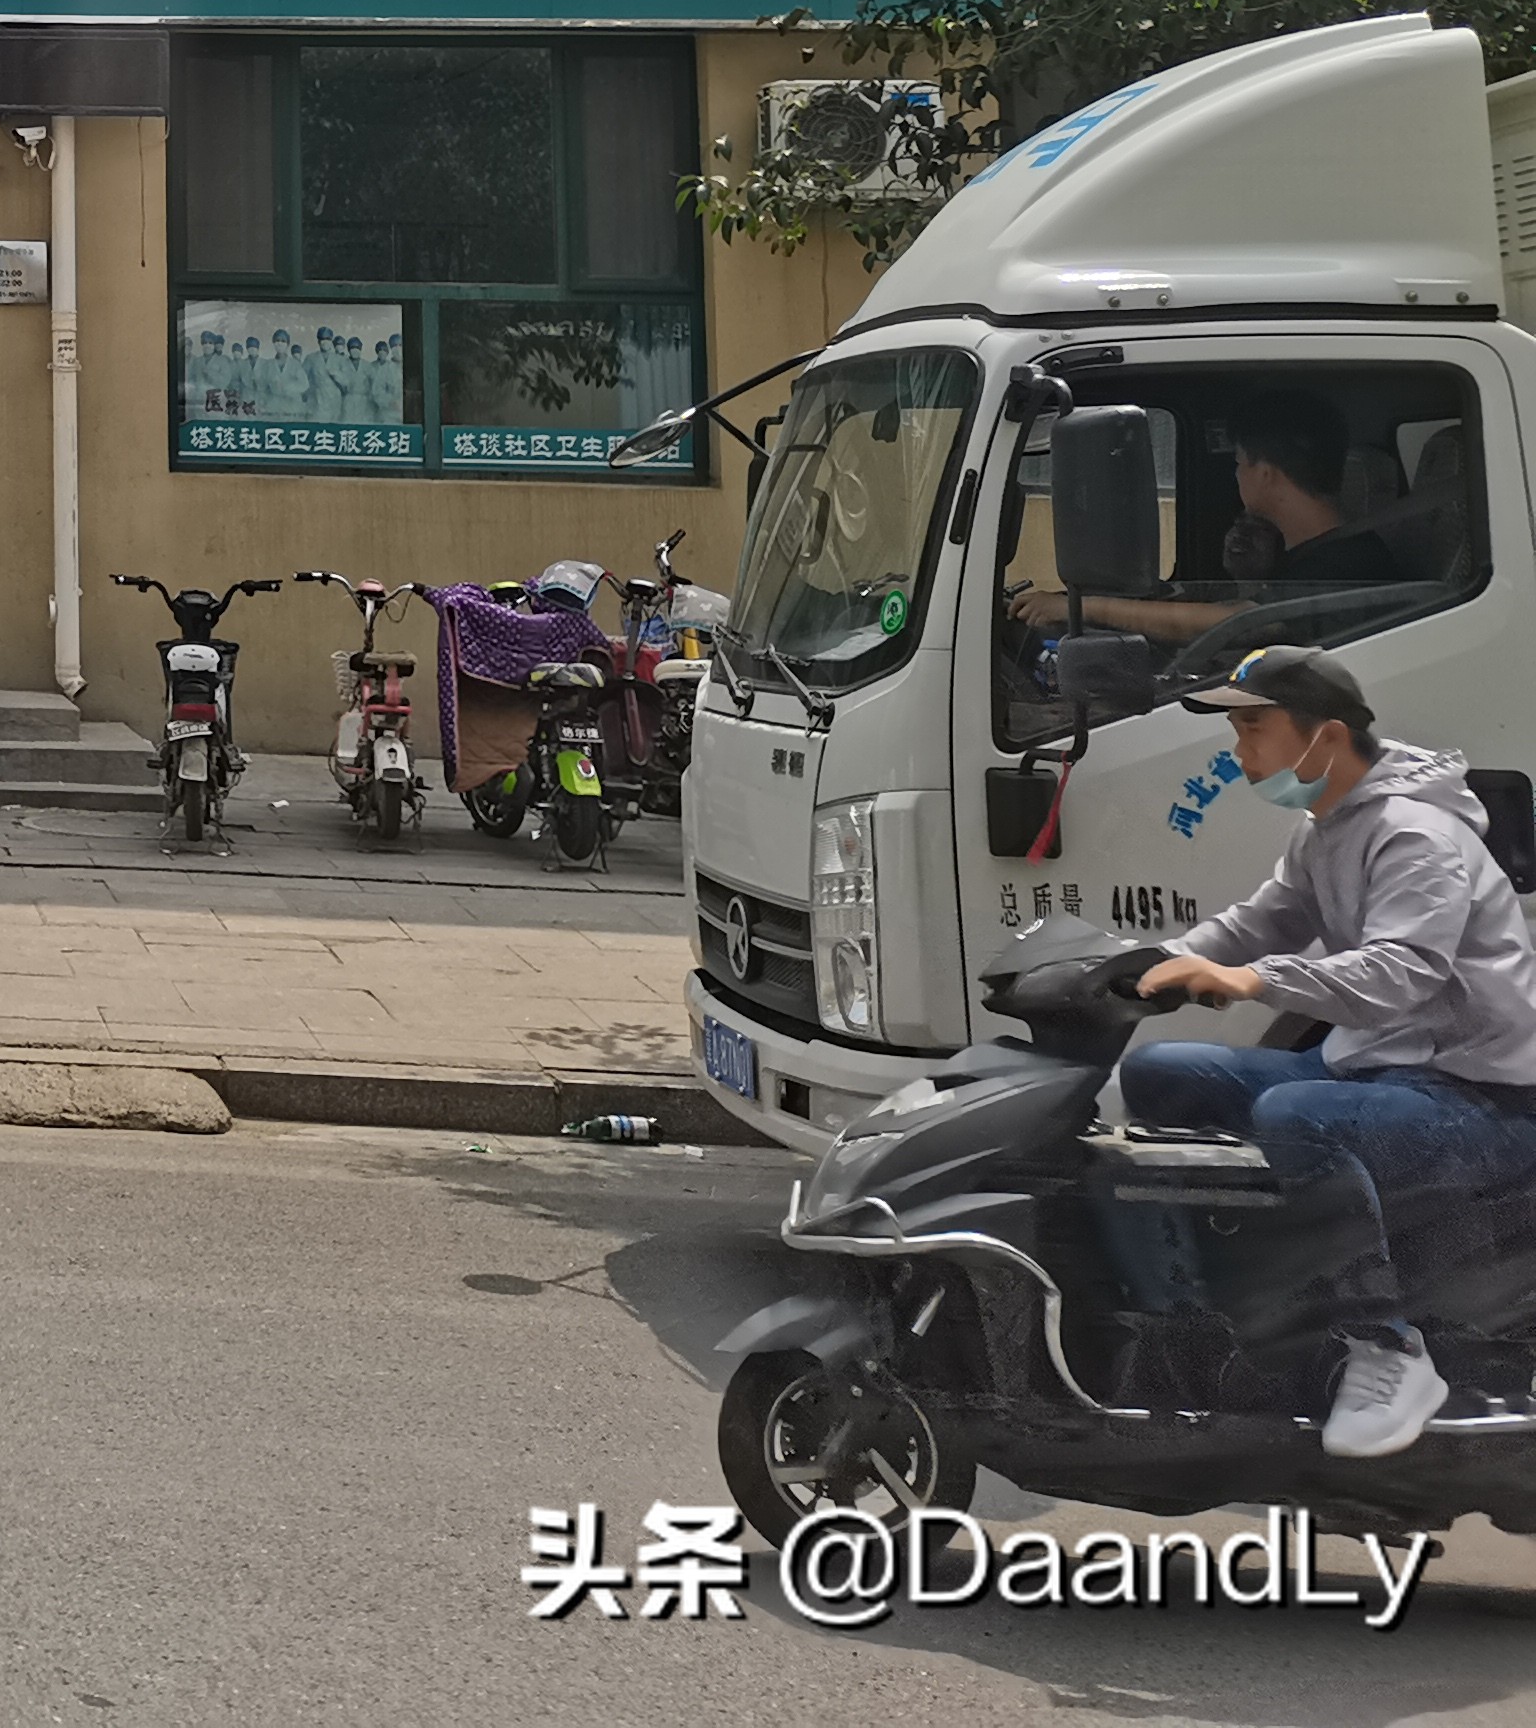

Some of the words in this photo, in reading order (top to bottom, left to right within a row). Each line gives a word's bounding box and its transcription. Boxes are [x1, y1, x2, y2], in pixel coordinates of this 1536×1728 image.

[190, 424, 412, 455] 塔谈社区卫生服务站
[999, 882, 1084, 928] 总质量
[1111, 885, 1164, 930] 4495
